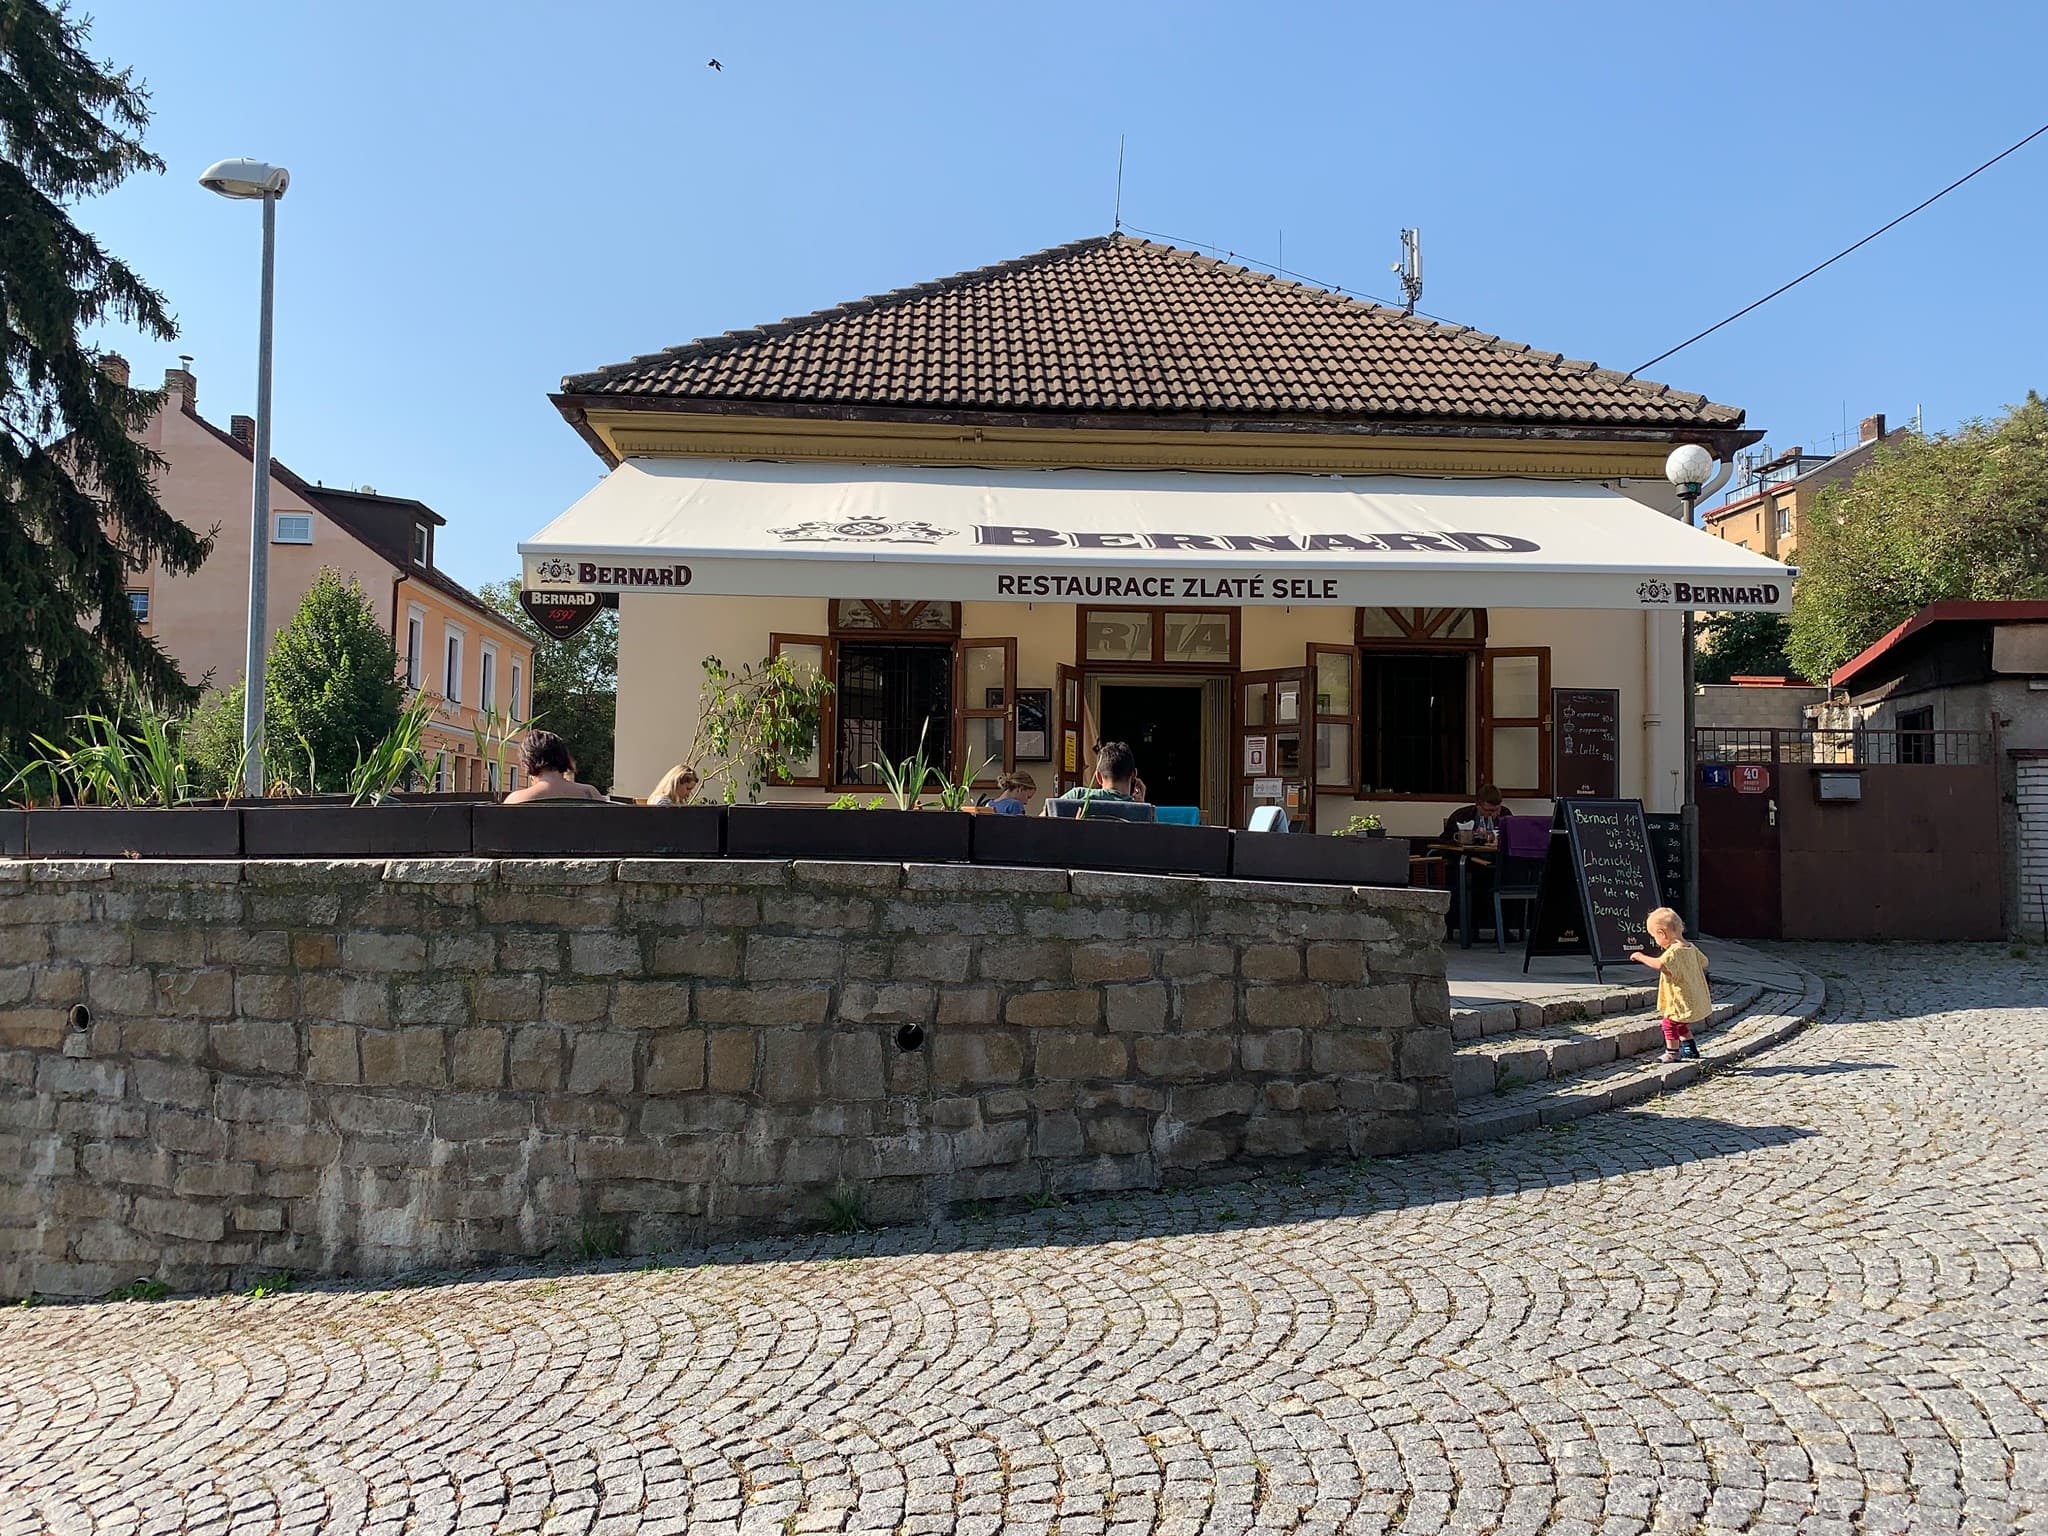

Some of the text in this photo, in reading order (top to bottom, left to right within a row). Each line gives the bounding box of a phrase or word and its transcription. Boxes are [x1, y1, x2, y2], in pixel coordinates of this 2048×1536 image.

[969, 524, 1541, 553] BERNARD
[578, 563, 692, 586] BERNARD
[997, 573, 1339, 599] RESTAURACE ZLATÉ SELE
[1673, 582, 1780, 604] BERNARD
[531, 592, 596, 606] BERNARD
[548, 609, 577, 622] 1597
[1713, 770, 1719, 783] 1
[1744, 767, 1759, 780] 40
[1574, 808, 1619, 825] Bernard
[1593, 901, 1630, 918] Bernard
